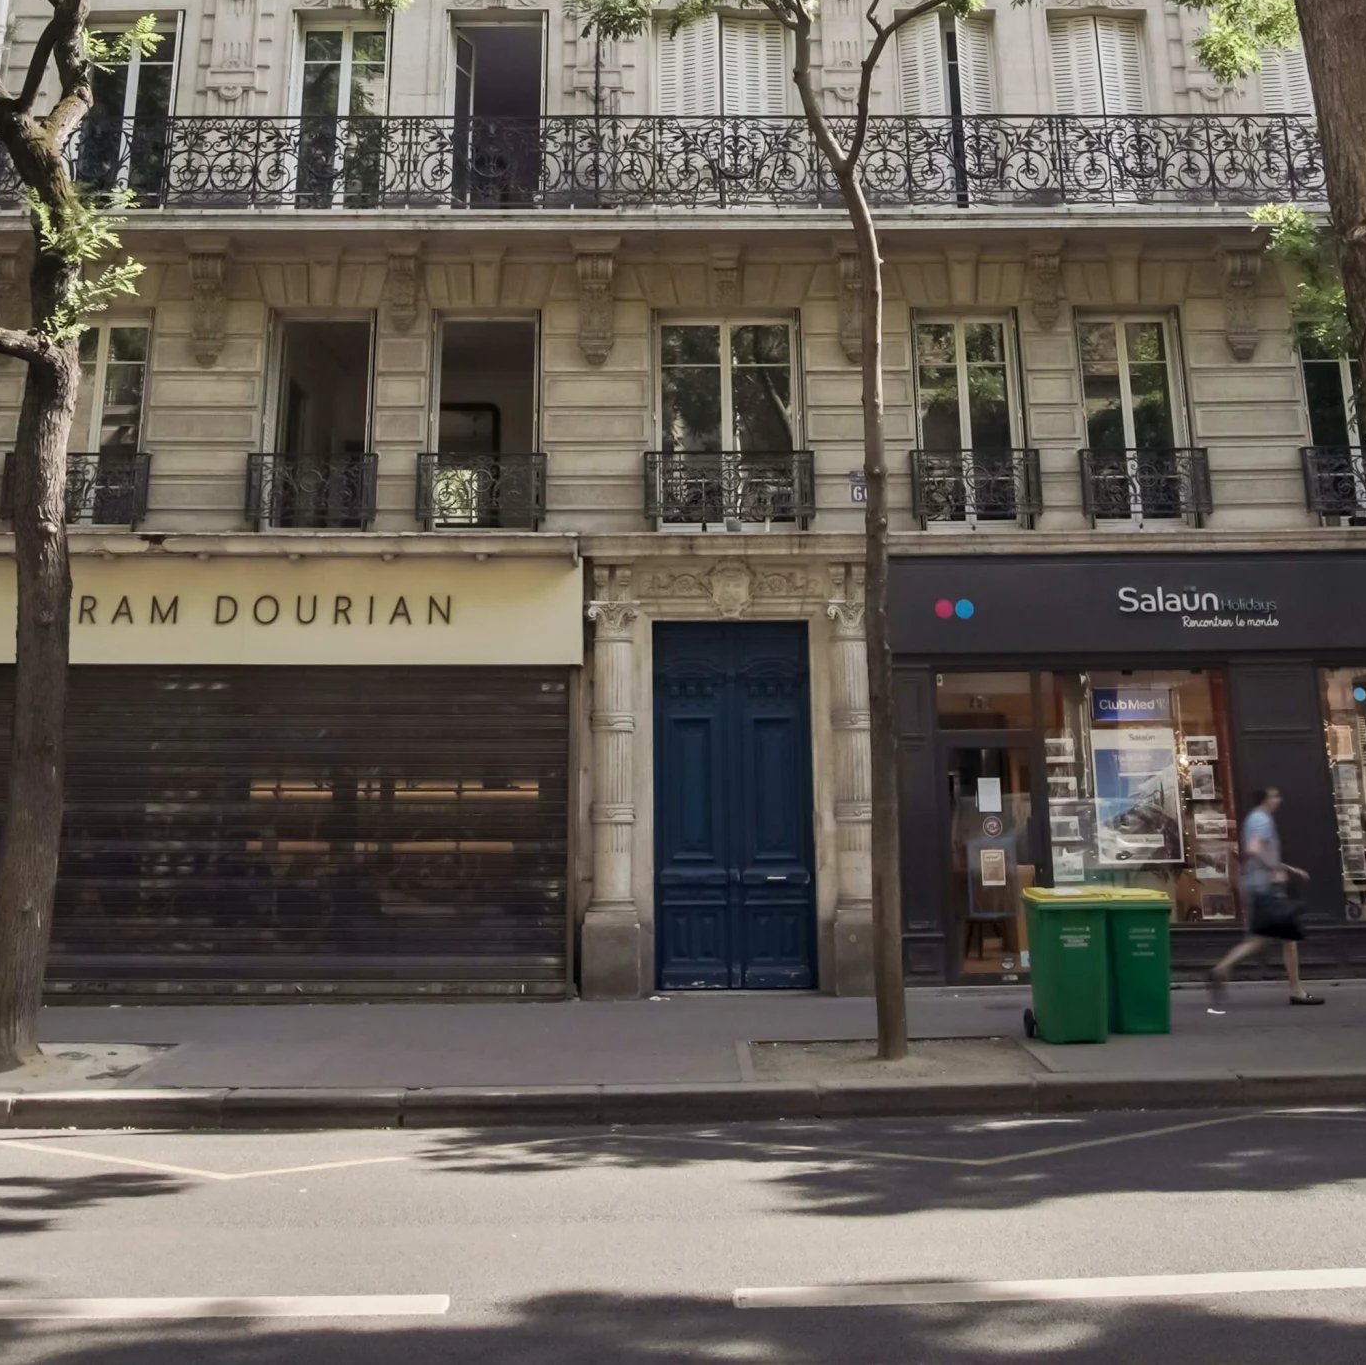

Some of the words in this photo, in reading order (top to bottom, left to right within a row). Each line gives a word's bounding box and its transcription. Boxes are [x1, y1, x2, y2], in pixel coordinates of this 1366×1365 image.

[78, 595, 179, 624] RAM
[215, 595, 452, 624] DOURIAN
[1118, 586, 1219, 612] Salaün
[1221, 597, 1277, 613] Holidays
[1182, 615, 1234, 628] Rencontrer
[1235, 614, 1245, 627] le
[1246, 614, 1279, 627] monde
